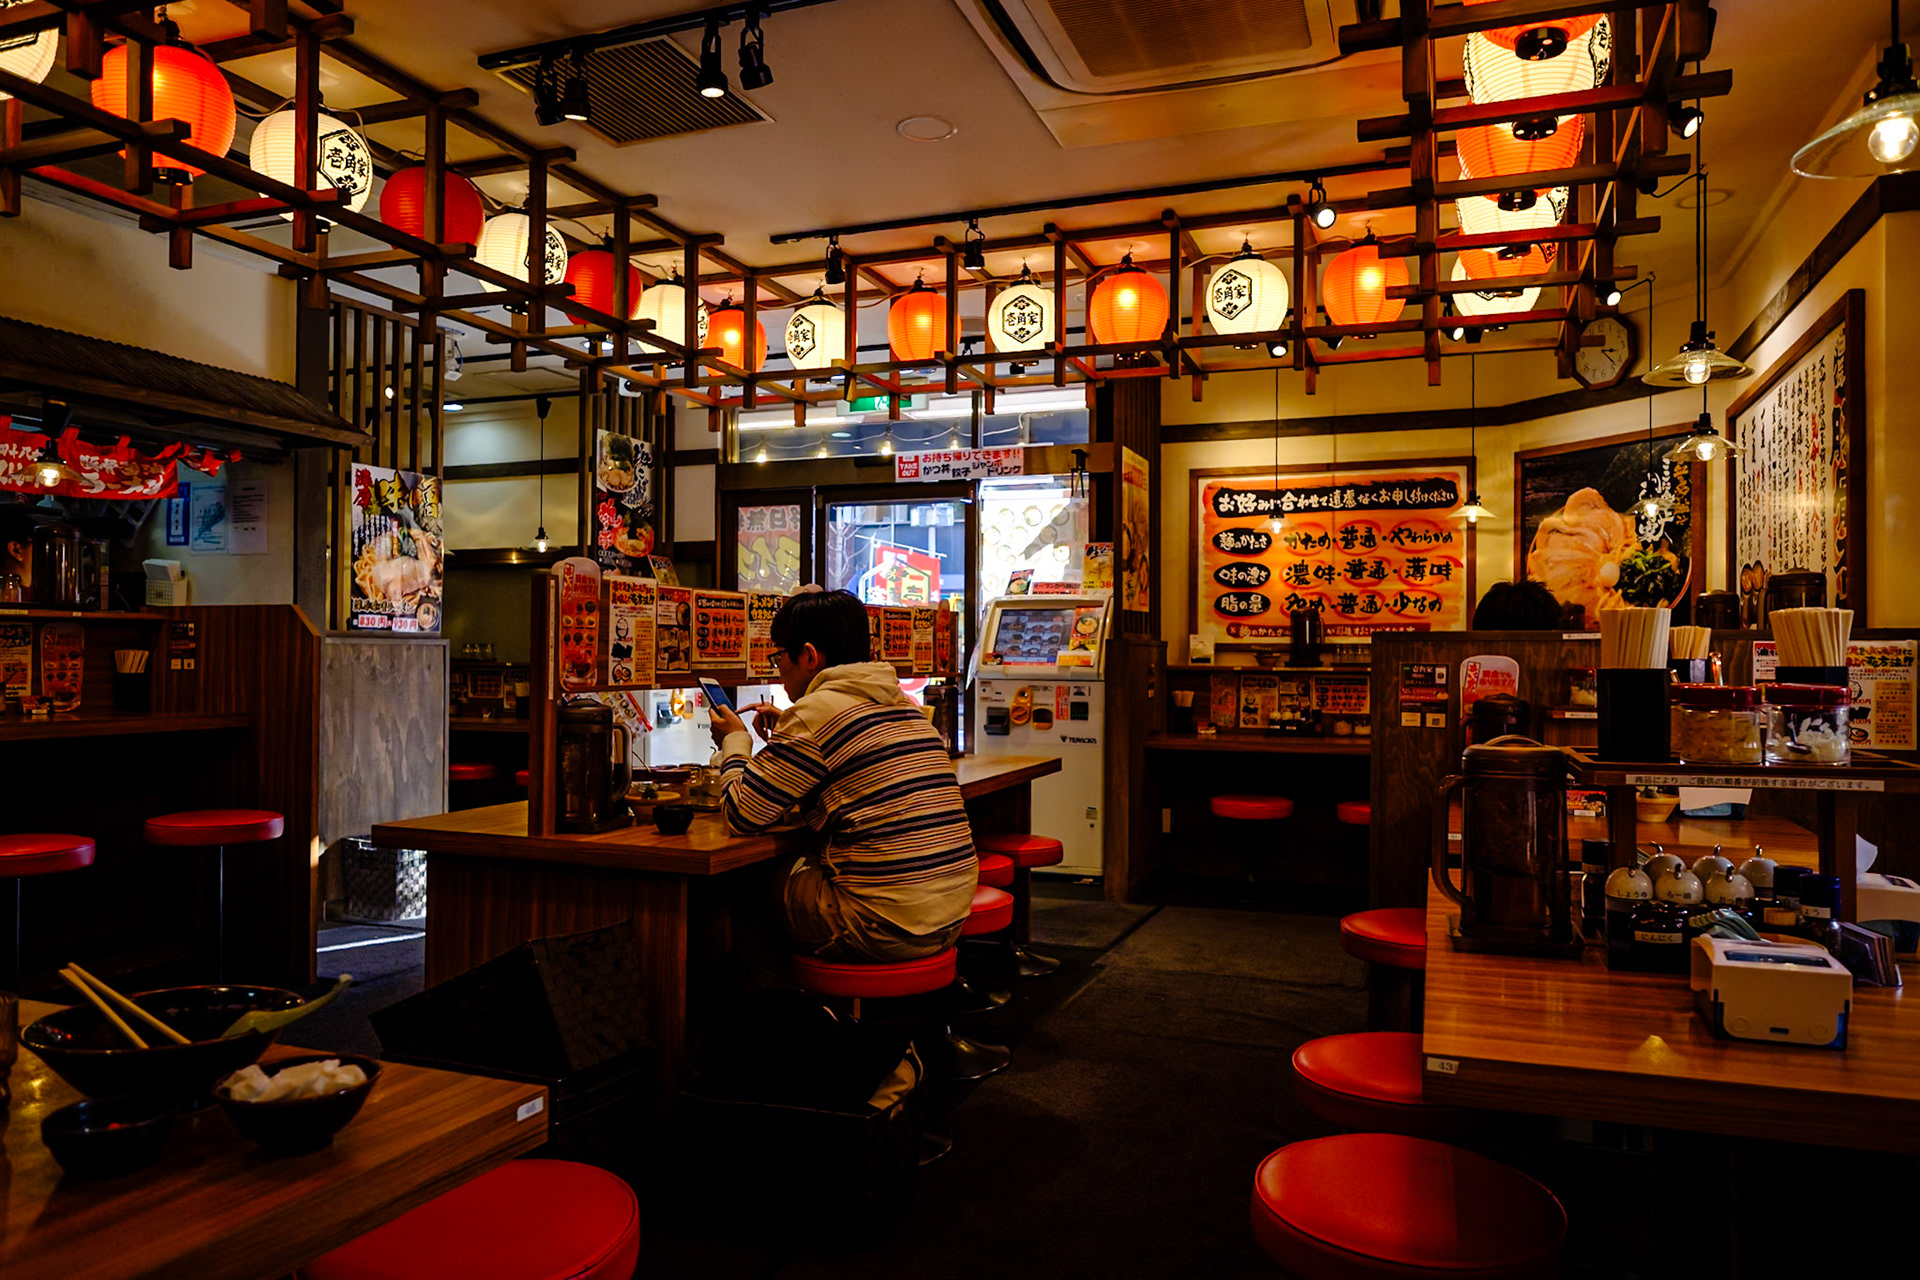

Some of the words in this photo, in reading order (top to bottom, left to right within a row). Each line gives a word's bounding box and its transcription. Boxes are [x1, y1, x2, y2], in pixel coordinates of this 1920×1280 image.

[326, 147, 368, 177] 壱角家
[545, 250, 564, 270] 角家
[1213, 284, 1246, 303] 壱角家
[1006, 311, 1039, 327] 壱角家
[922, 448, 1020, 463] お持ち帰りできます!!
[1219, 531, 1268, 551] 麺のかたさ
[1218, 566, 1268, 585] 味の濃さ
[1220, 593, 1264, 613] 脂の量
[1641, 933, 1673, 943] にんにく
